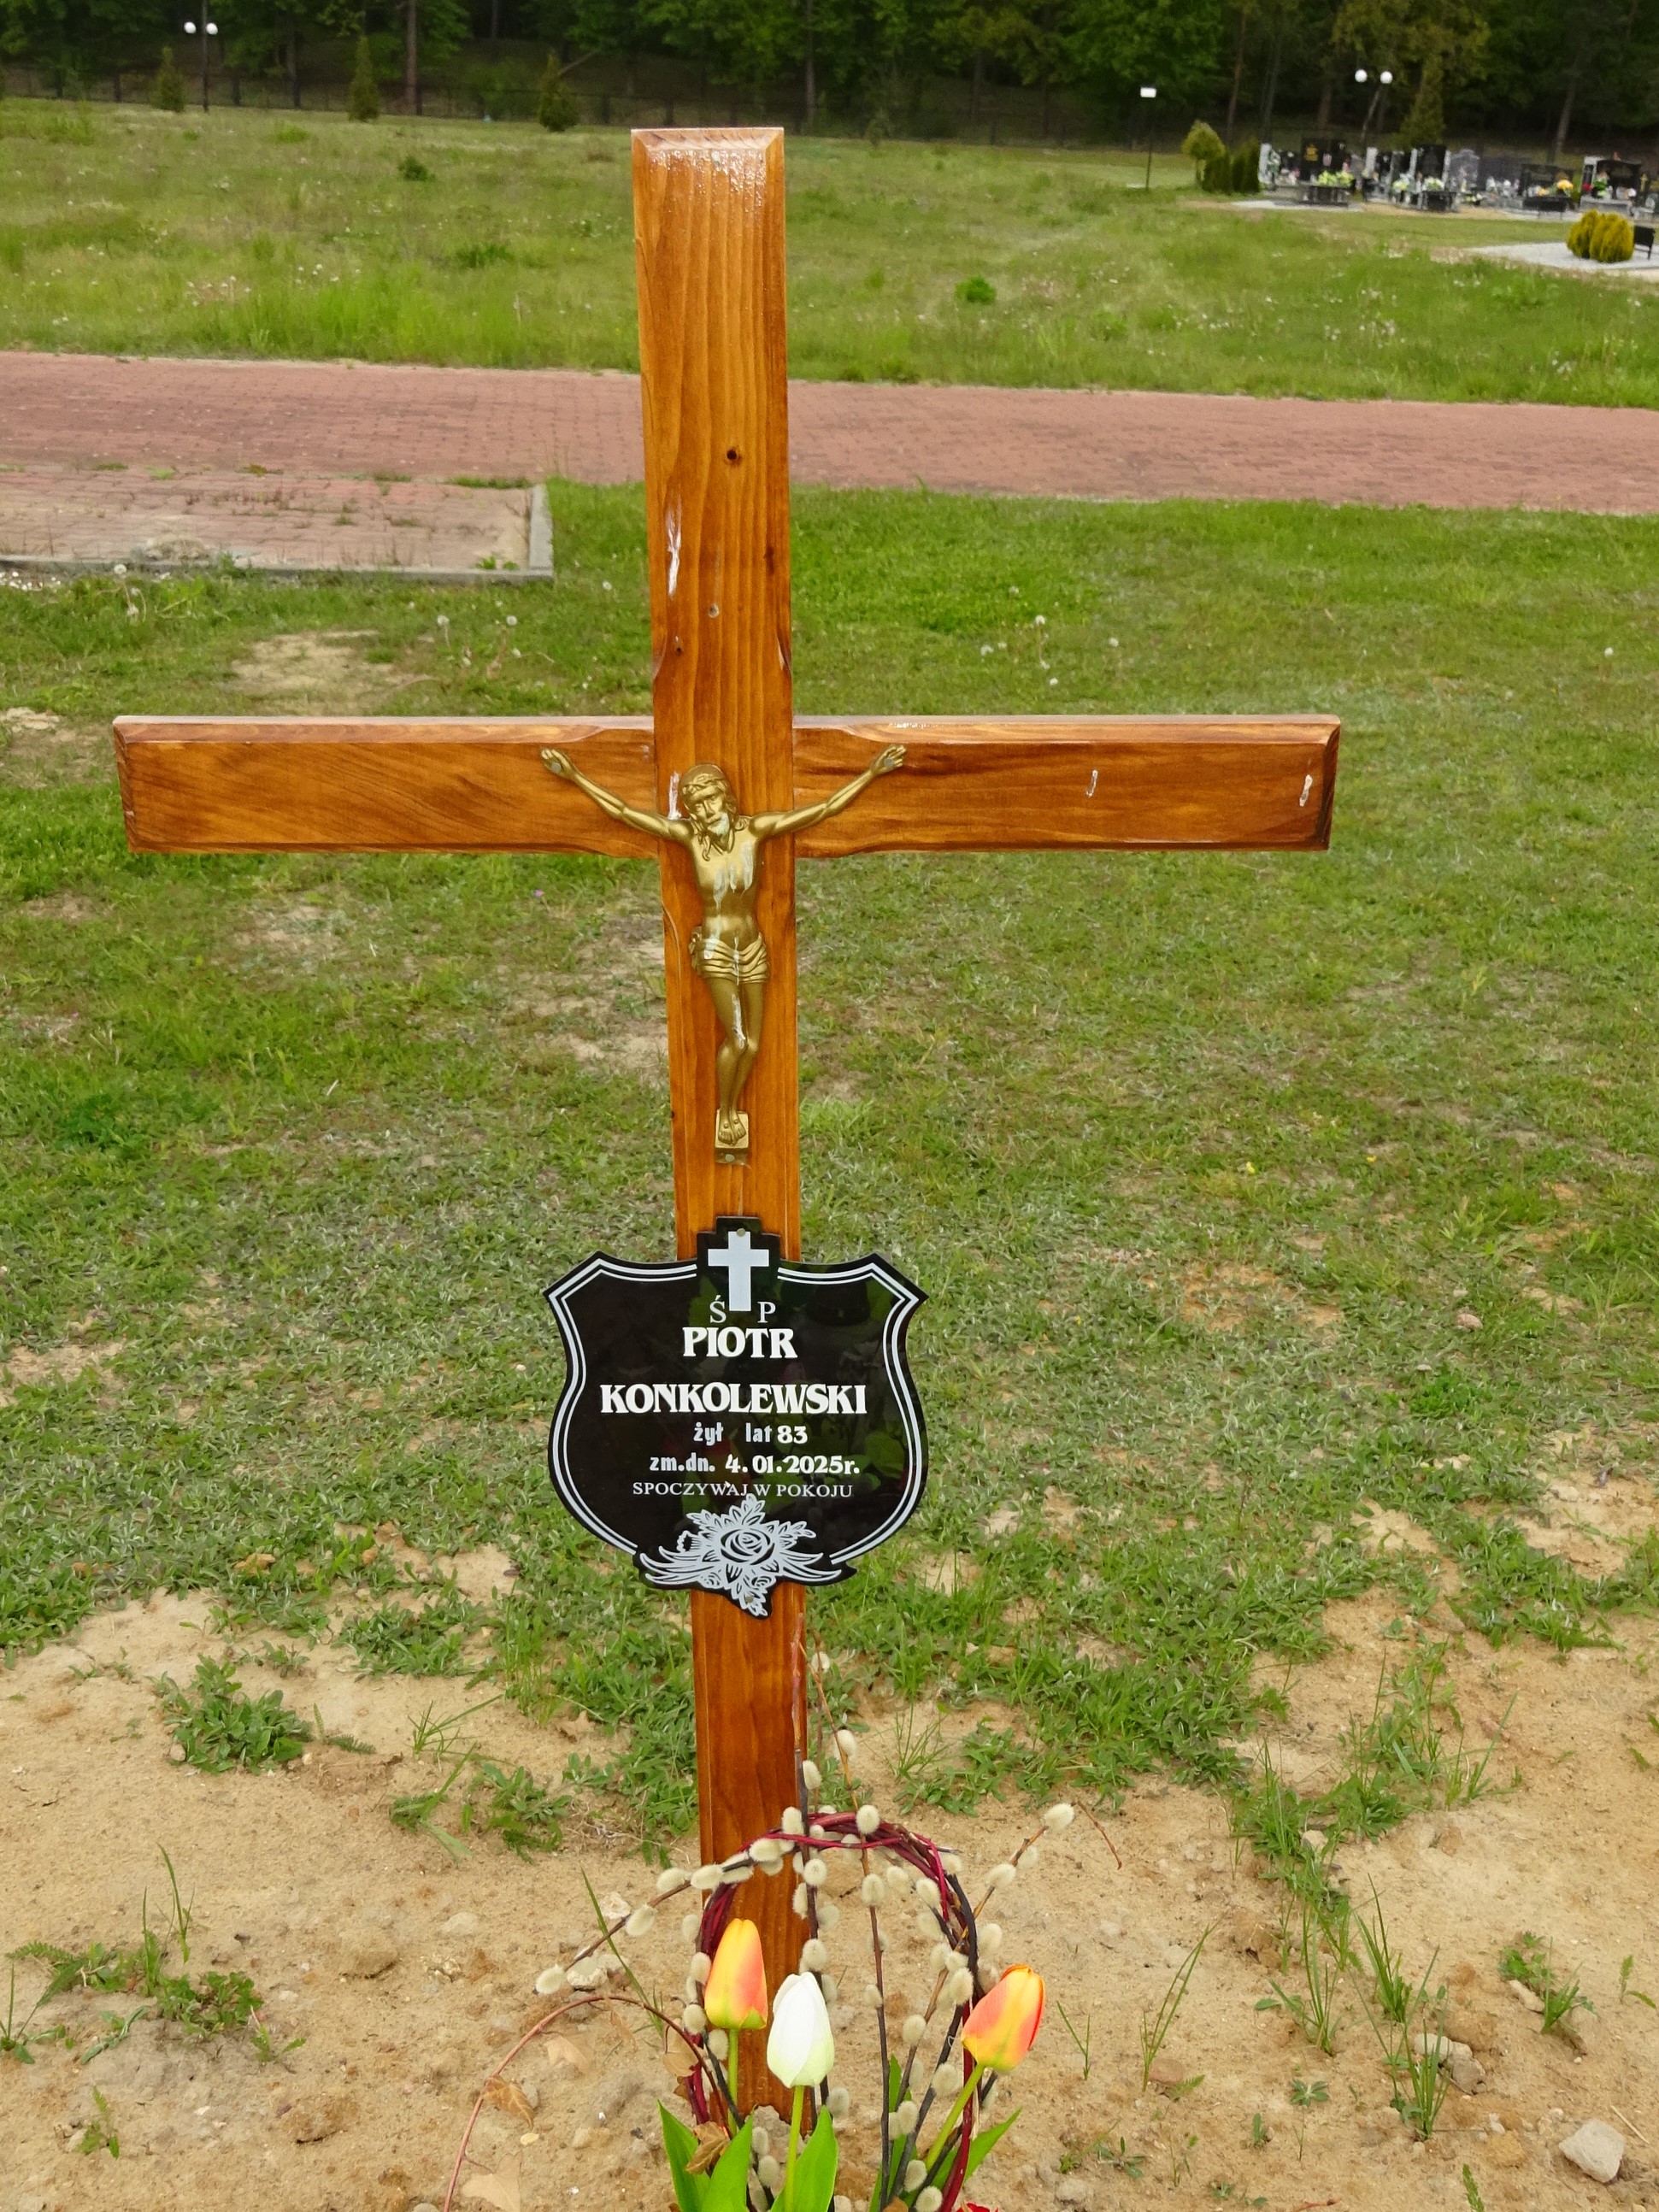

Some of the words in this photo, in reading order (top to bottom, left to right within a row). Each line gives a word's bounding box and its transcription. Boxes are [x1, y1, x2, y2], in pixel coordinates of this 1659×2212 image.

[709, 1295, 727, 1323] Ś
[757, 1301, 776, 1323] P
[683, 1327, 797, 1358] PIOTR
[600, 1381, 867, 1414] KONKOLEWSKI
[693, 1422, 723, 1446] żył
[745, 1422, 771, 1442] lat
[777, 1425, 808, 1444] 83
[632, 1481, 748, 1496] SPOCZYWAJ
[753, 1484, 772, 1497] W
[776, 1484, 853, 1497] POKOJU
